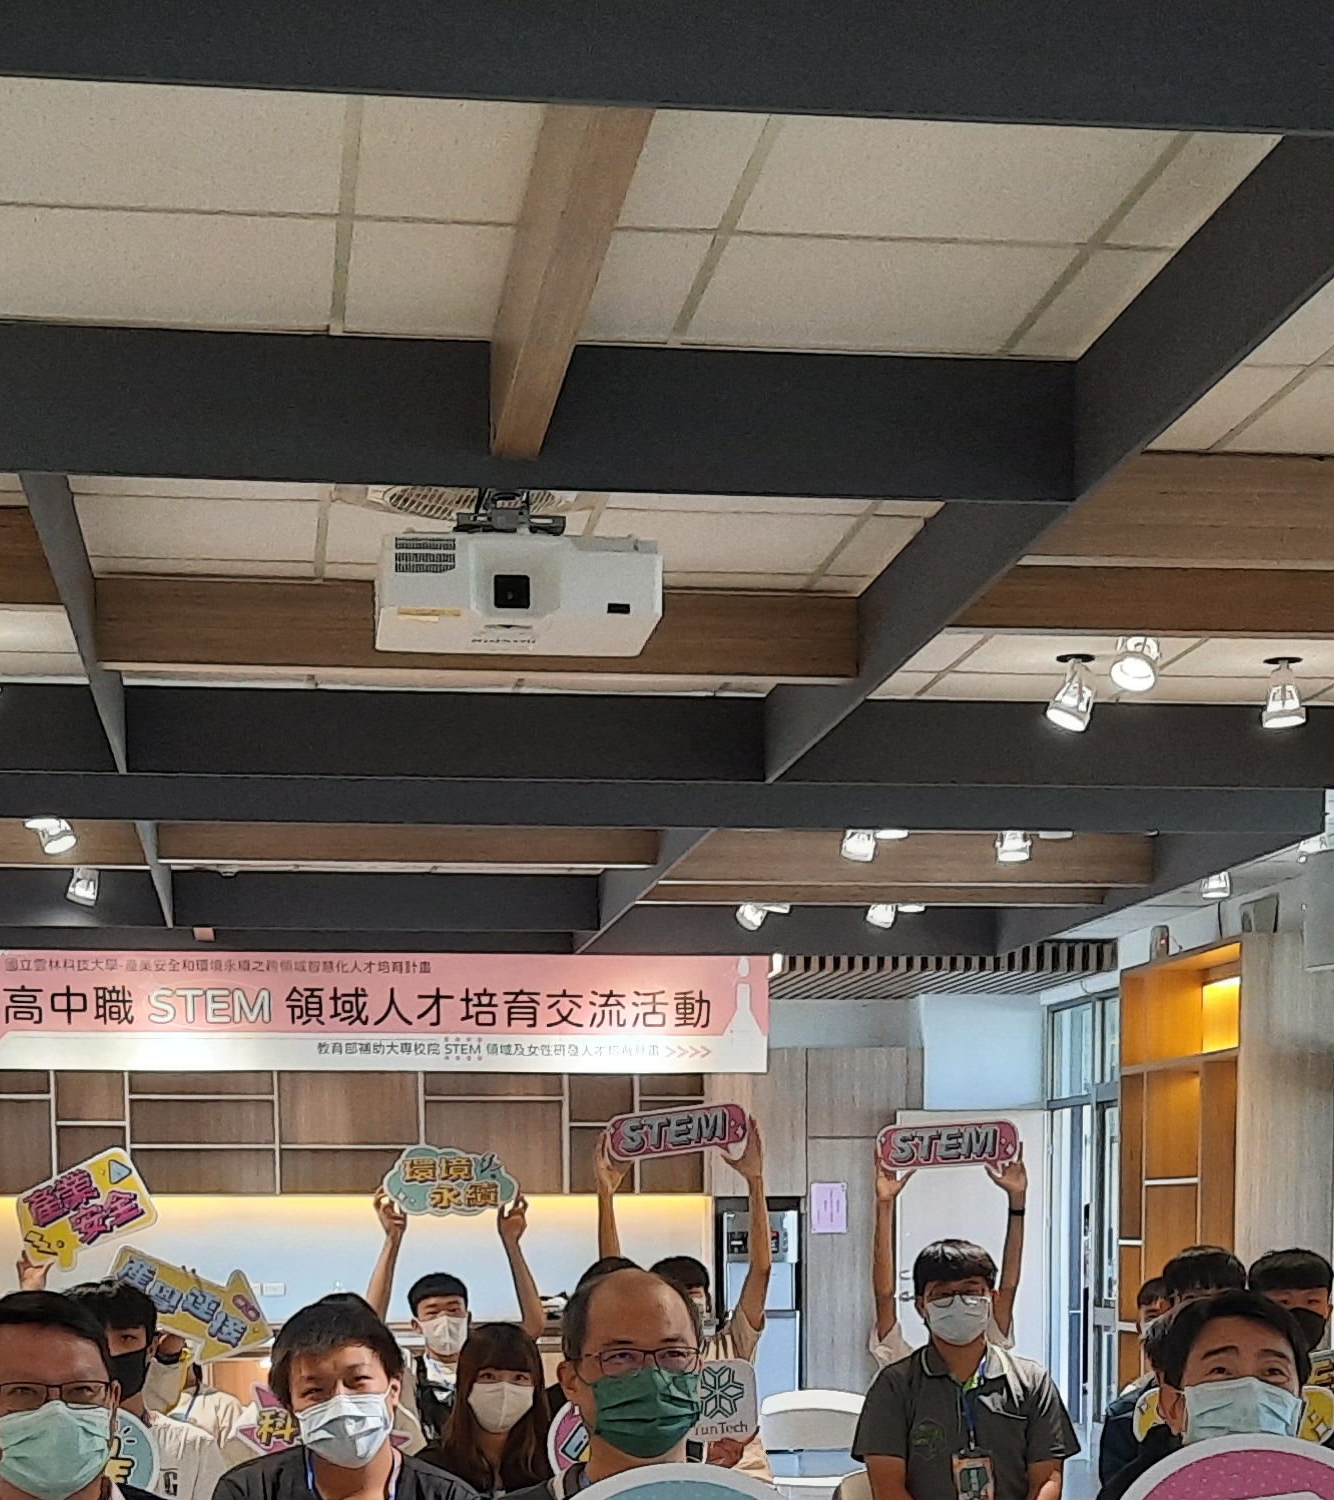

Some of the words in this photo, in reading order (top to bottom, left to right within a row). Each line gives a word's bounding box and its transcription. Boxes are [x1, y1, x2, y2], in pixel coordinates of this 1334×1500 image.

[3, 985, 134, 1025] 高中職
[148, 987, 272, 1024] STEM
[285, 986, 711, 1029] 領域人才培育交流活動
[444, 1043, 481, 1055] STEM
[619, 1108, 730, 1154] STEM
[890, 1126, 997, 1163] STEM
[403, 1156, 474, 1183] 環境
[23, 1169, 101, 1227] 產業
[429, 1181, 498, 1208] 永續
[68, 1190, 145, 1245] 安全
